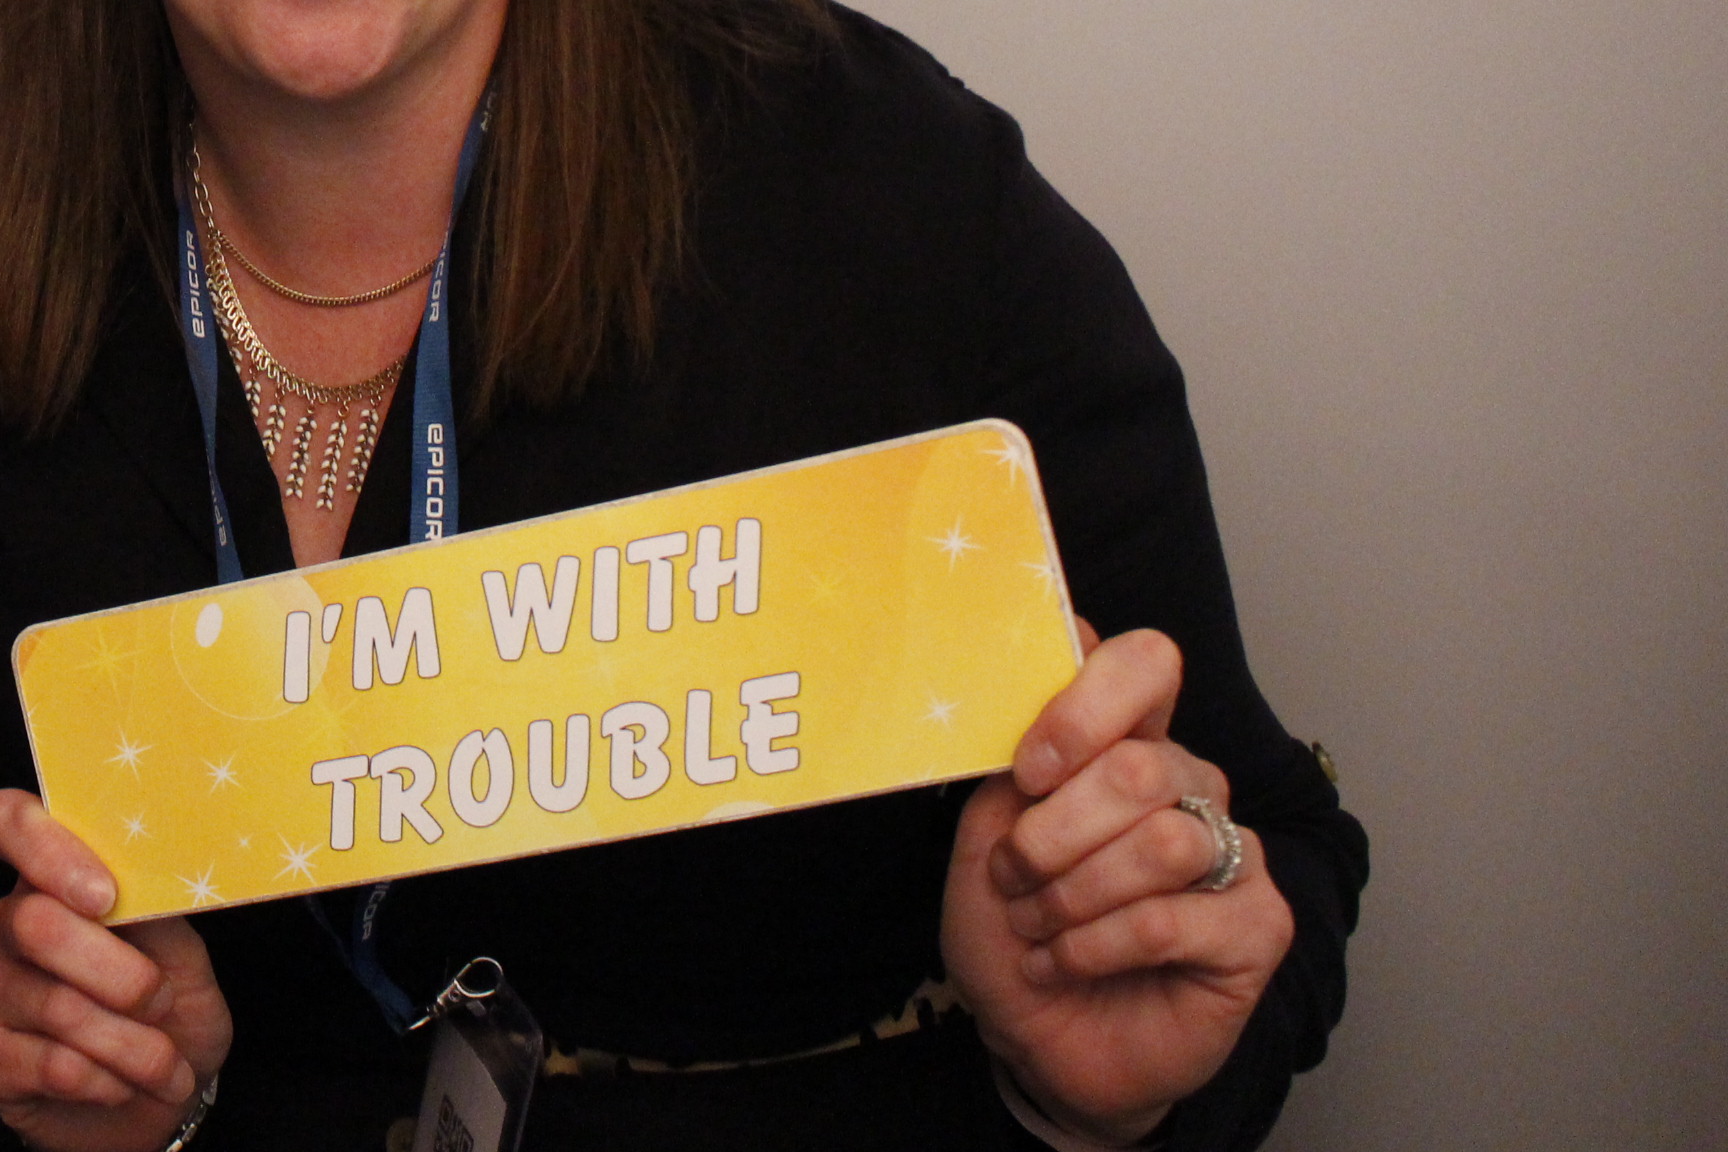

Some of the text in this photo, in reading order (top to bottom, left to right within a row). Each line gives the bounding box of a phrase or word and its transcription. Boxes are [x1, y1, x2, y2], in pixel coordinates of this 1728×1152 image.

[283, 517, 762, 703] I'M WITH
[311, 671, 800, 851] TROUBLE
